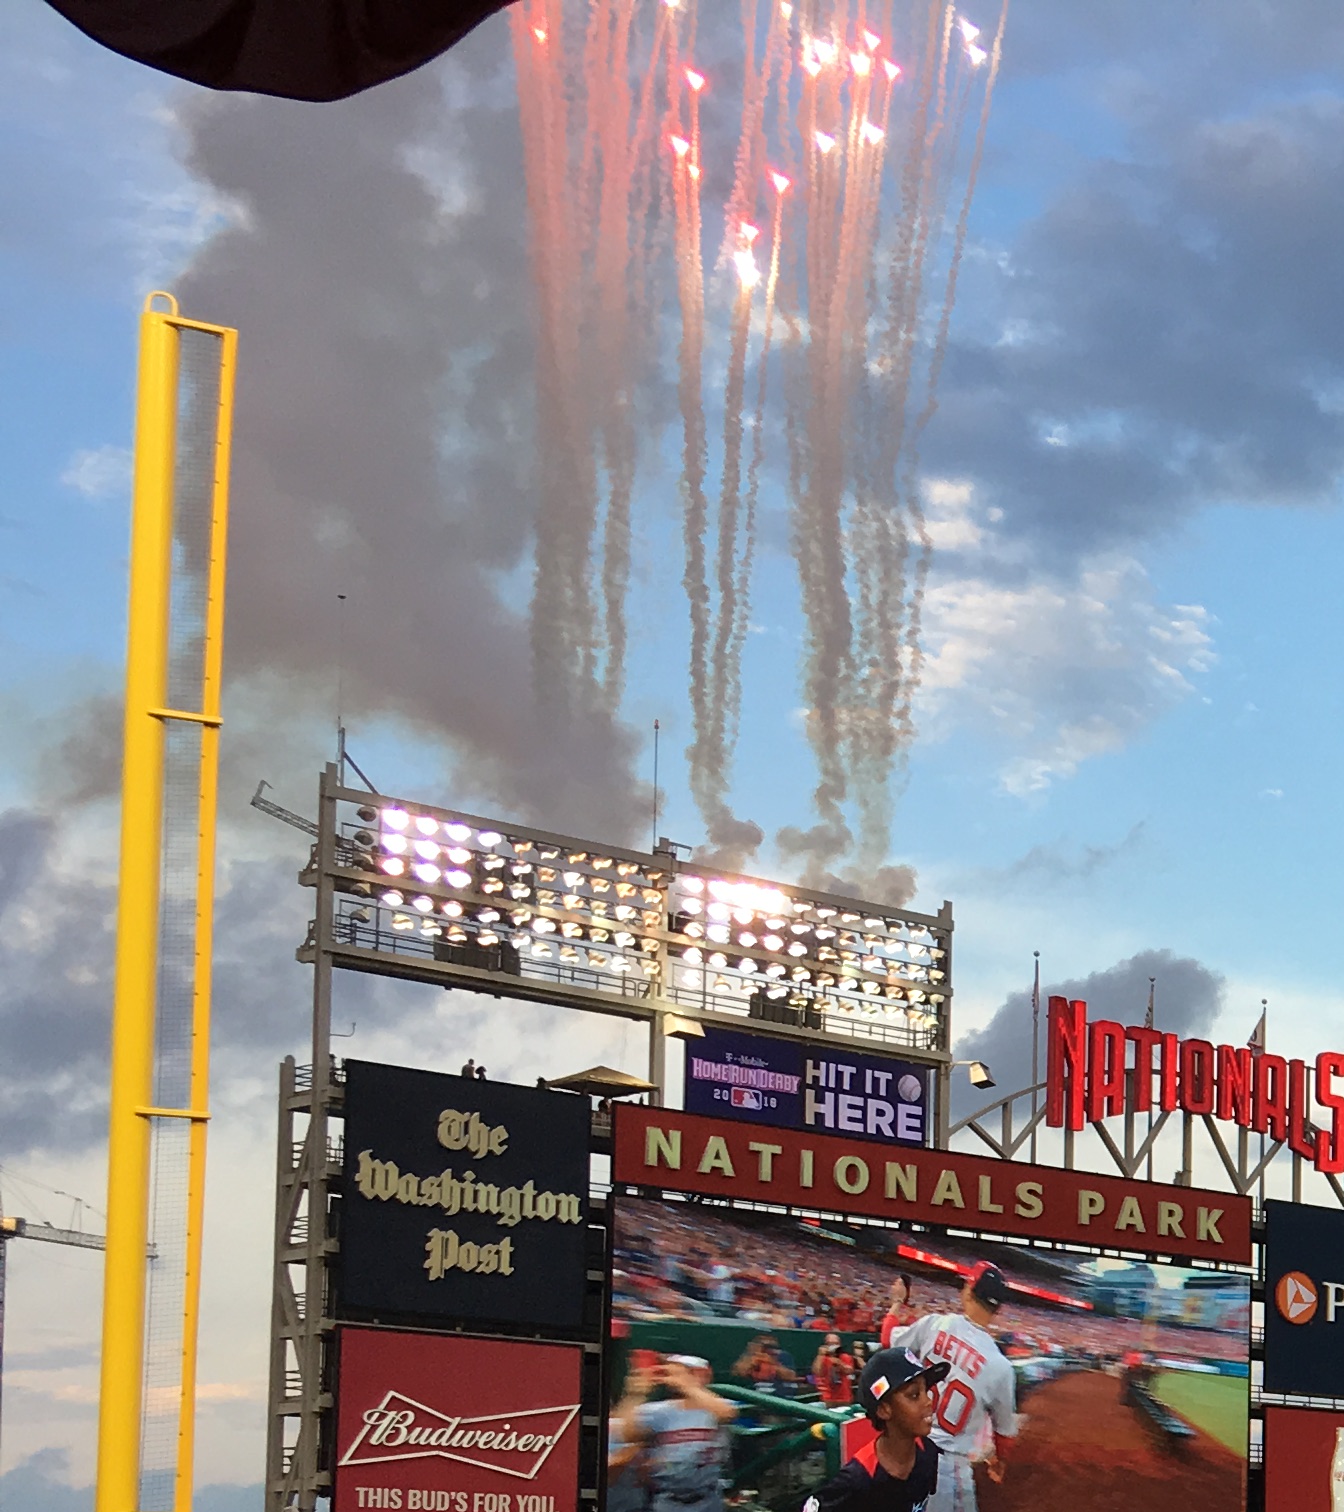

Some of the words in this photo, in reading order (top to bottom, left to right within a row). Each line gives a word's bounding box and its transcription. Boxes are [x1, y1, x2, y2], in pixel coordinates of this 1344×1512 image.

[692, 1057, 729, 1082] HOME
[729, 1063, 759, 1088] RUN
[759, 1068, 801, 1094] DERBY
[713, 1088, 729, 1101] 20
[806, 1059, 857, 1091] HIT
[865, 1069, 893, 1096] IT
[438, 1109, 509, 1159] The
[805, 1088, 923, 1142] HERE
[355, 1149, 583, 1227] Washington
[645, 1126, 1044, 1219] NATIONALS
[1078, 1190, 1225, 1244] PARK
[423, 1228, 514, 1281] Post
[933, 1330, 988, 1379] BETTS
[363, 1409, 555, 1452] Budweiser
[355, 1487, 402, 1509] THIS
[408, 1490, 468, 1512] BUD'S
